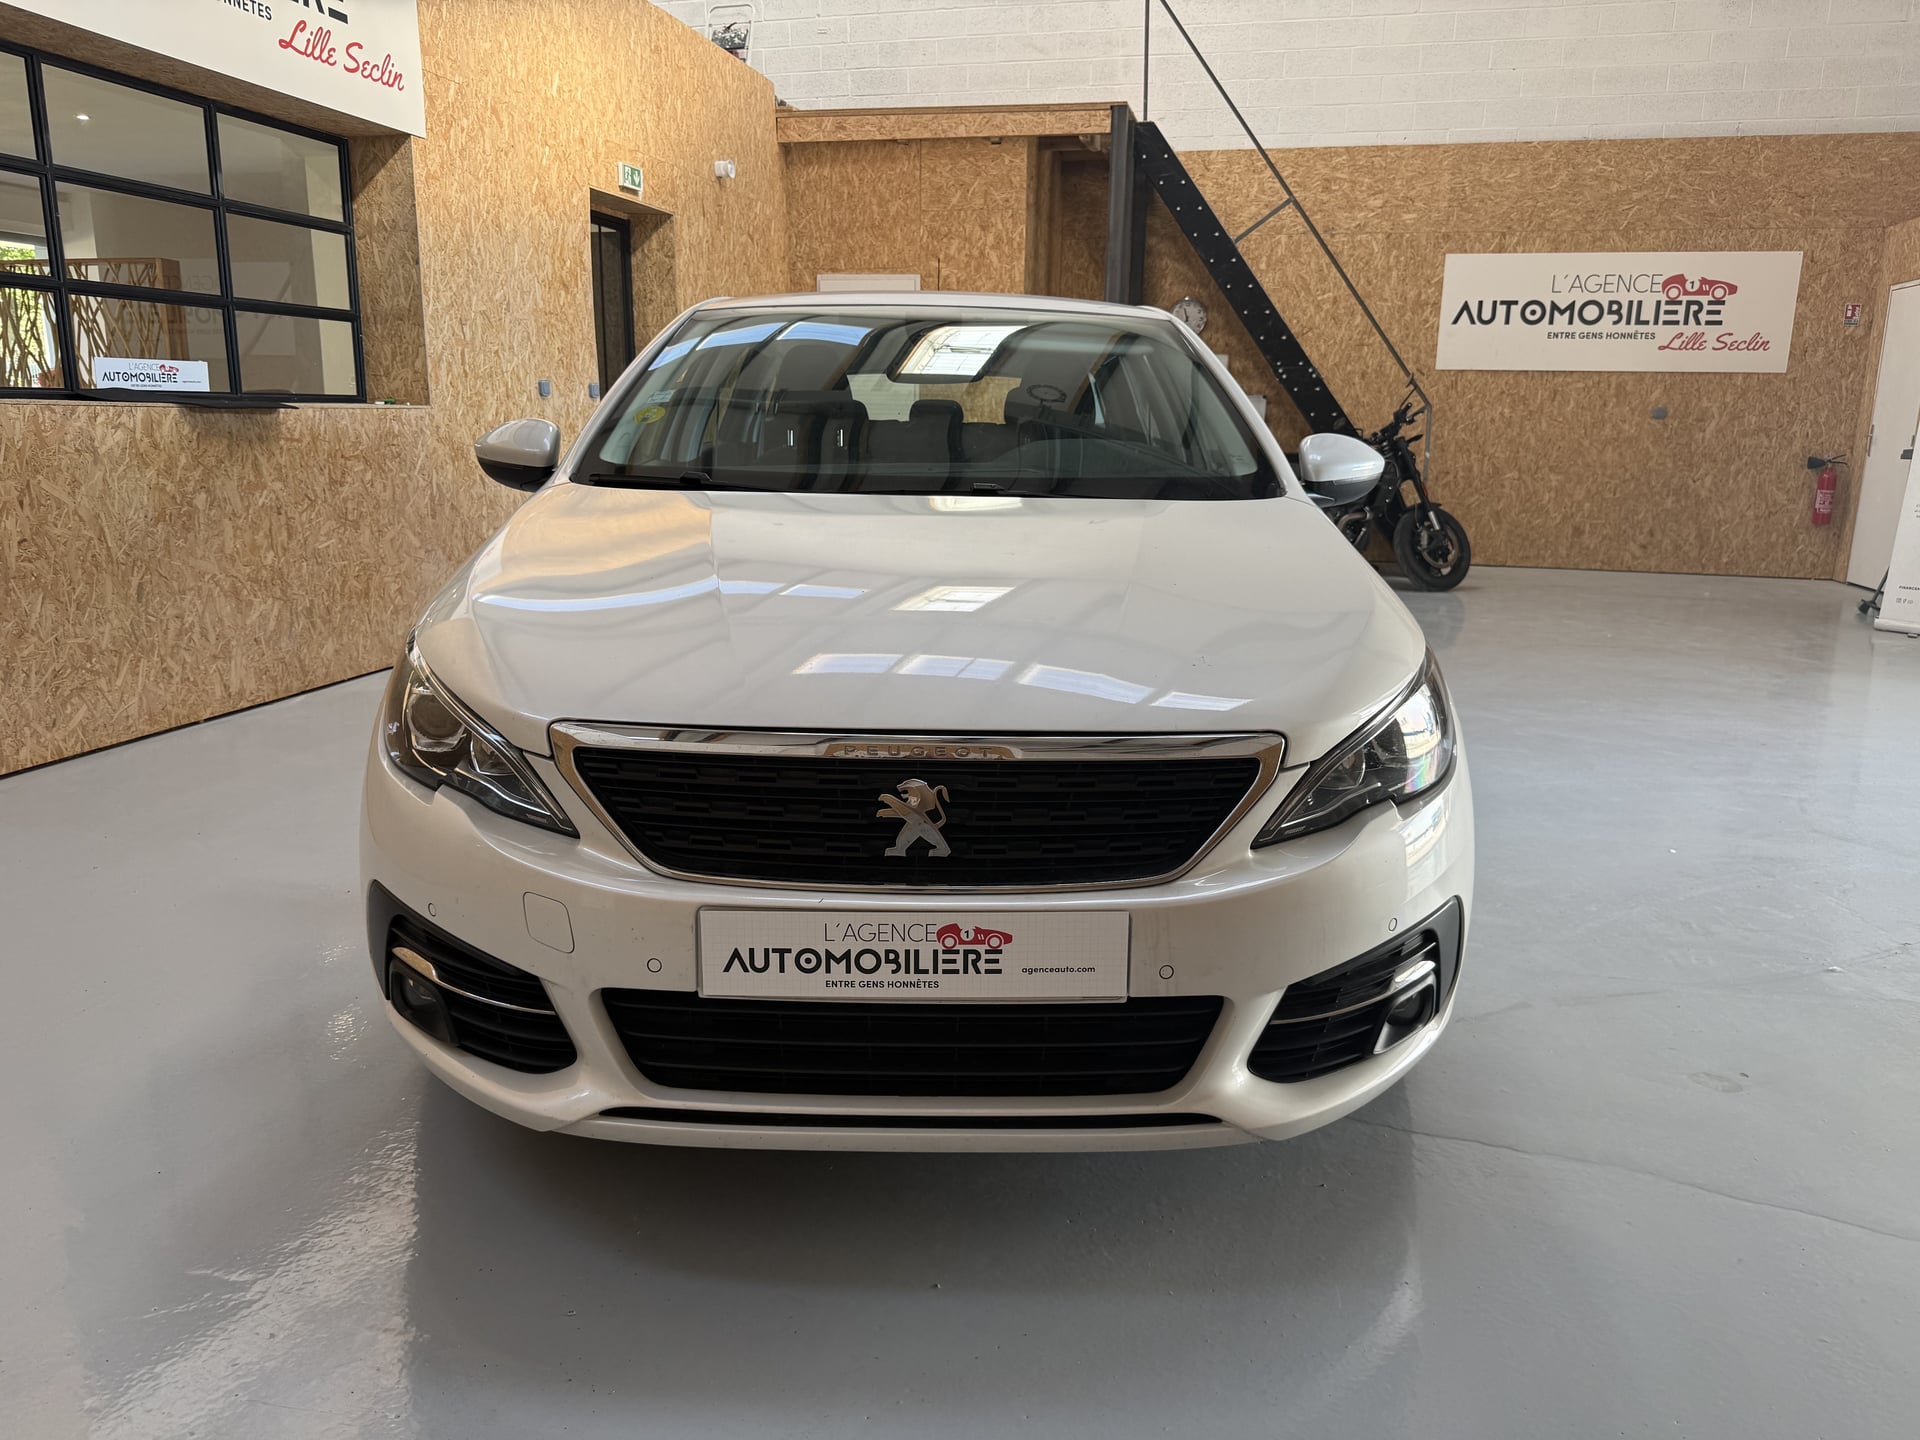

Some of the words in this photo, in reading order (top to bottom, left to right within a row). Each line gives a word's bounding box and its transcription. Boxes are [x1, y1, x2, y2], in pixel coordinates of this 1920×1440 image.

[278, 19, 337, 66] Lille
[343, 41, 405, 91] Seclin
[1551, 273, 1663, 293] L'AGENCE
[1547, 331, 1576, 339] ENTRE
[1578, 331, 1604, 339] GENS
[1605, 329, 1656, 340] HONNÊTES
[1657, 331, 1708, 351] Lille
[1711, 331, 1771, 351] Seclin
[844, 745, 993, 758] PEUGEOT
[824, 923, 938, 942] L'AGENCE
[1021, 965, 1096, 976] agenceauto.com
[825, 980, 856, 988] ENTRE
[858, 980, 885, 988] GENS
[887, 978, 940, 988] HONNÊTES
